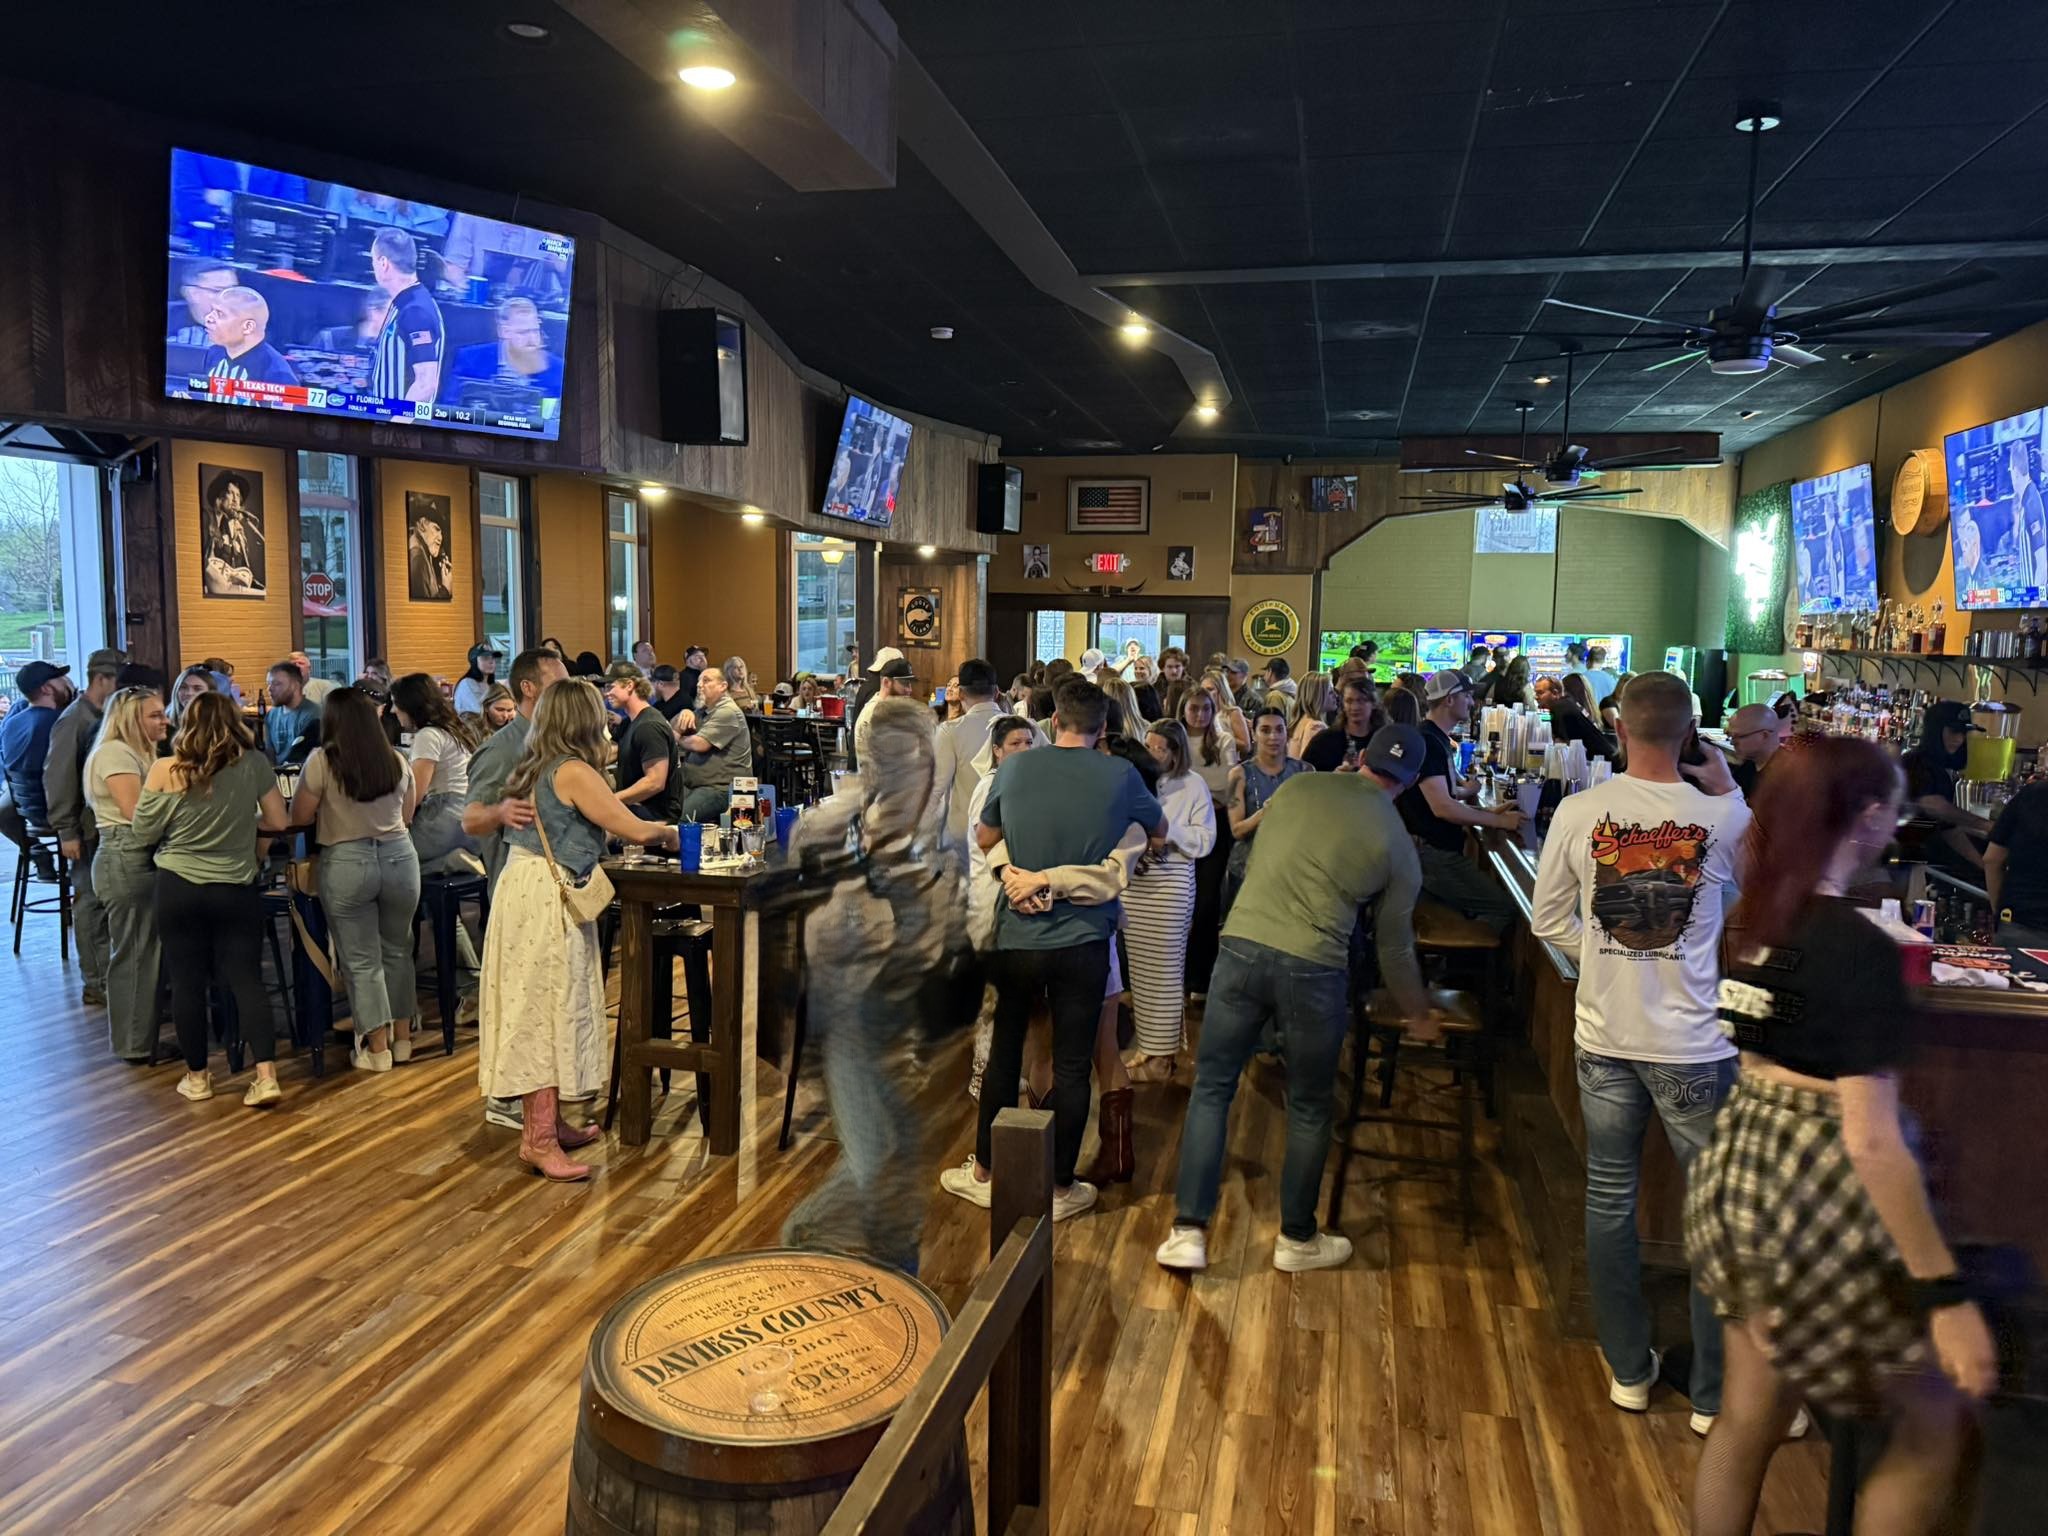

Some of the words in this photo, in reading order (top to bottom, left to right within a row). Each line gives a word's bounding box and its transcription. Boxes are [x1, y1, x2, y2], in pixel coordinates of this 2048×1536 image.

[189, 378, 208, 389] tbs
[243, 380, 267, 392] TEXAS
[267, 382, 286, 394] TECH
[311, 391, 325, 404] 77
[356, 395, 384, 405] FLORIDA
[417, 404, 430, 416] 80
[455, 410, 471, 421] 10.2
[1097, 553, 1119, 571] EXIT
[305, 583, 331, 597] STOP
[1591, 820, 1709, 859] Schaeffer's
[1599, 947, 1644, 958] SPECIALIZED
[631, 1322, 764, 1387] DAVIESS
[760, 1282, 887, 1335] COUNTY
[791, 1362, 850, 1391] 96
